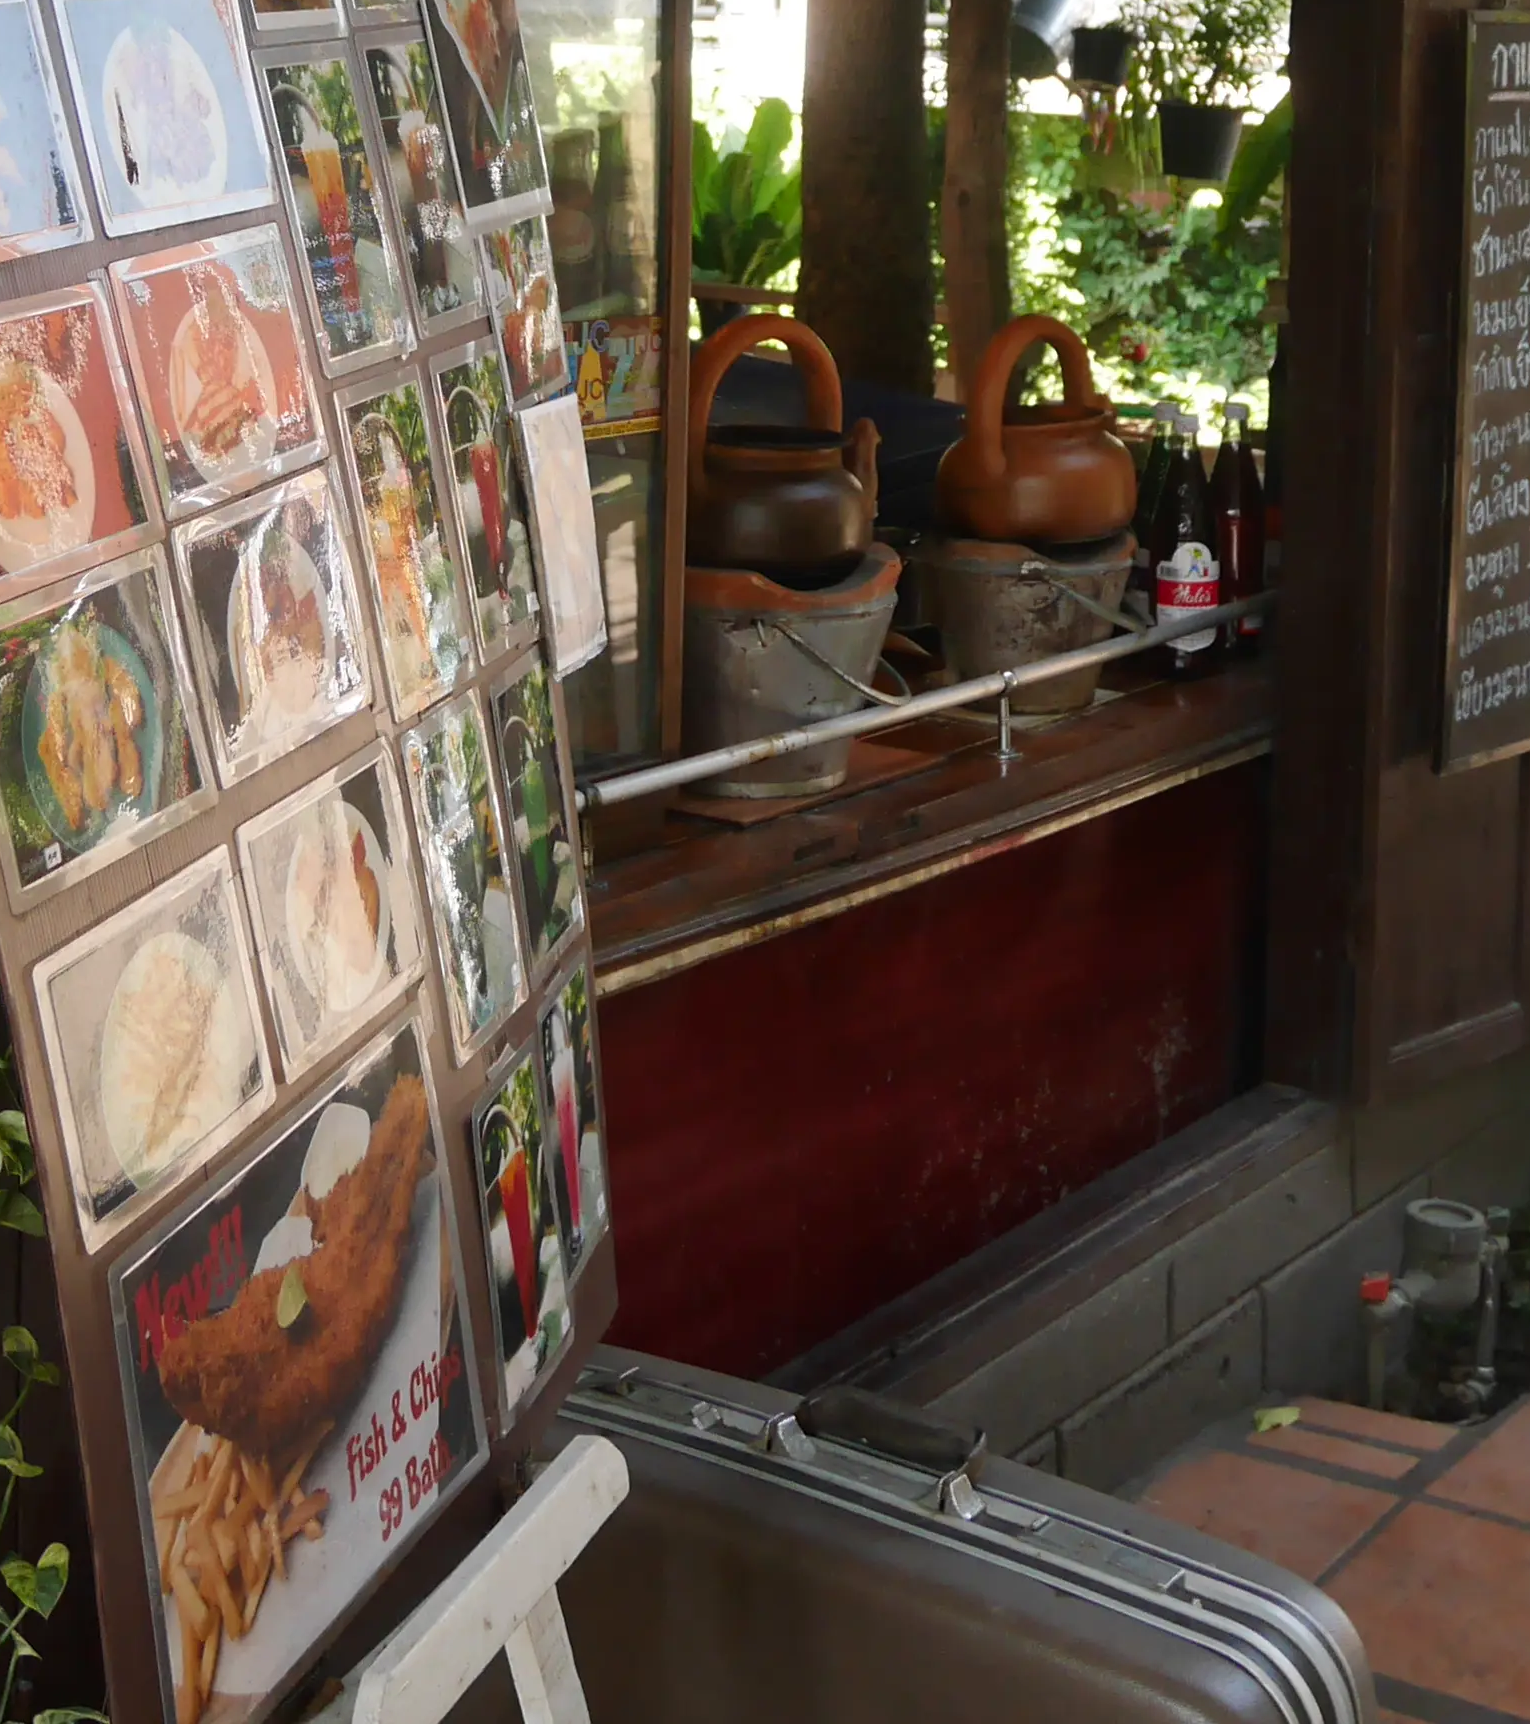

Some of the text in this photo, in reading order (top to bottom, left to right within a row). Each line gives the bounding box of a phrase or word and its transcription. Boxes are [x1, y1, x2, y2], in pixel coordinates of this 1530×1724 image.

[346, 1344, 461, 1502] Fish & Chips
[379, 1477, 404, 1542] 99
